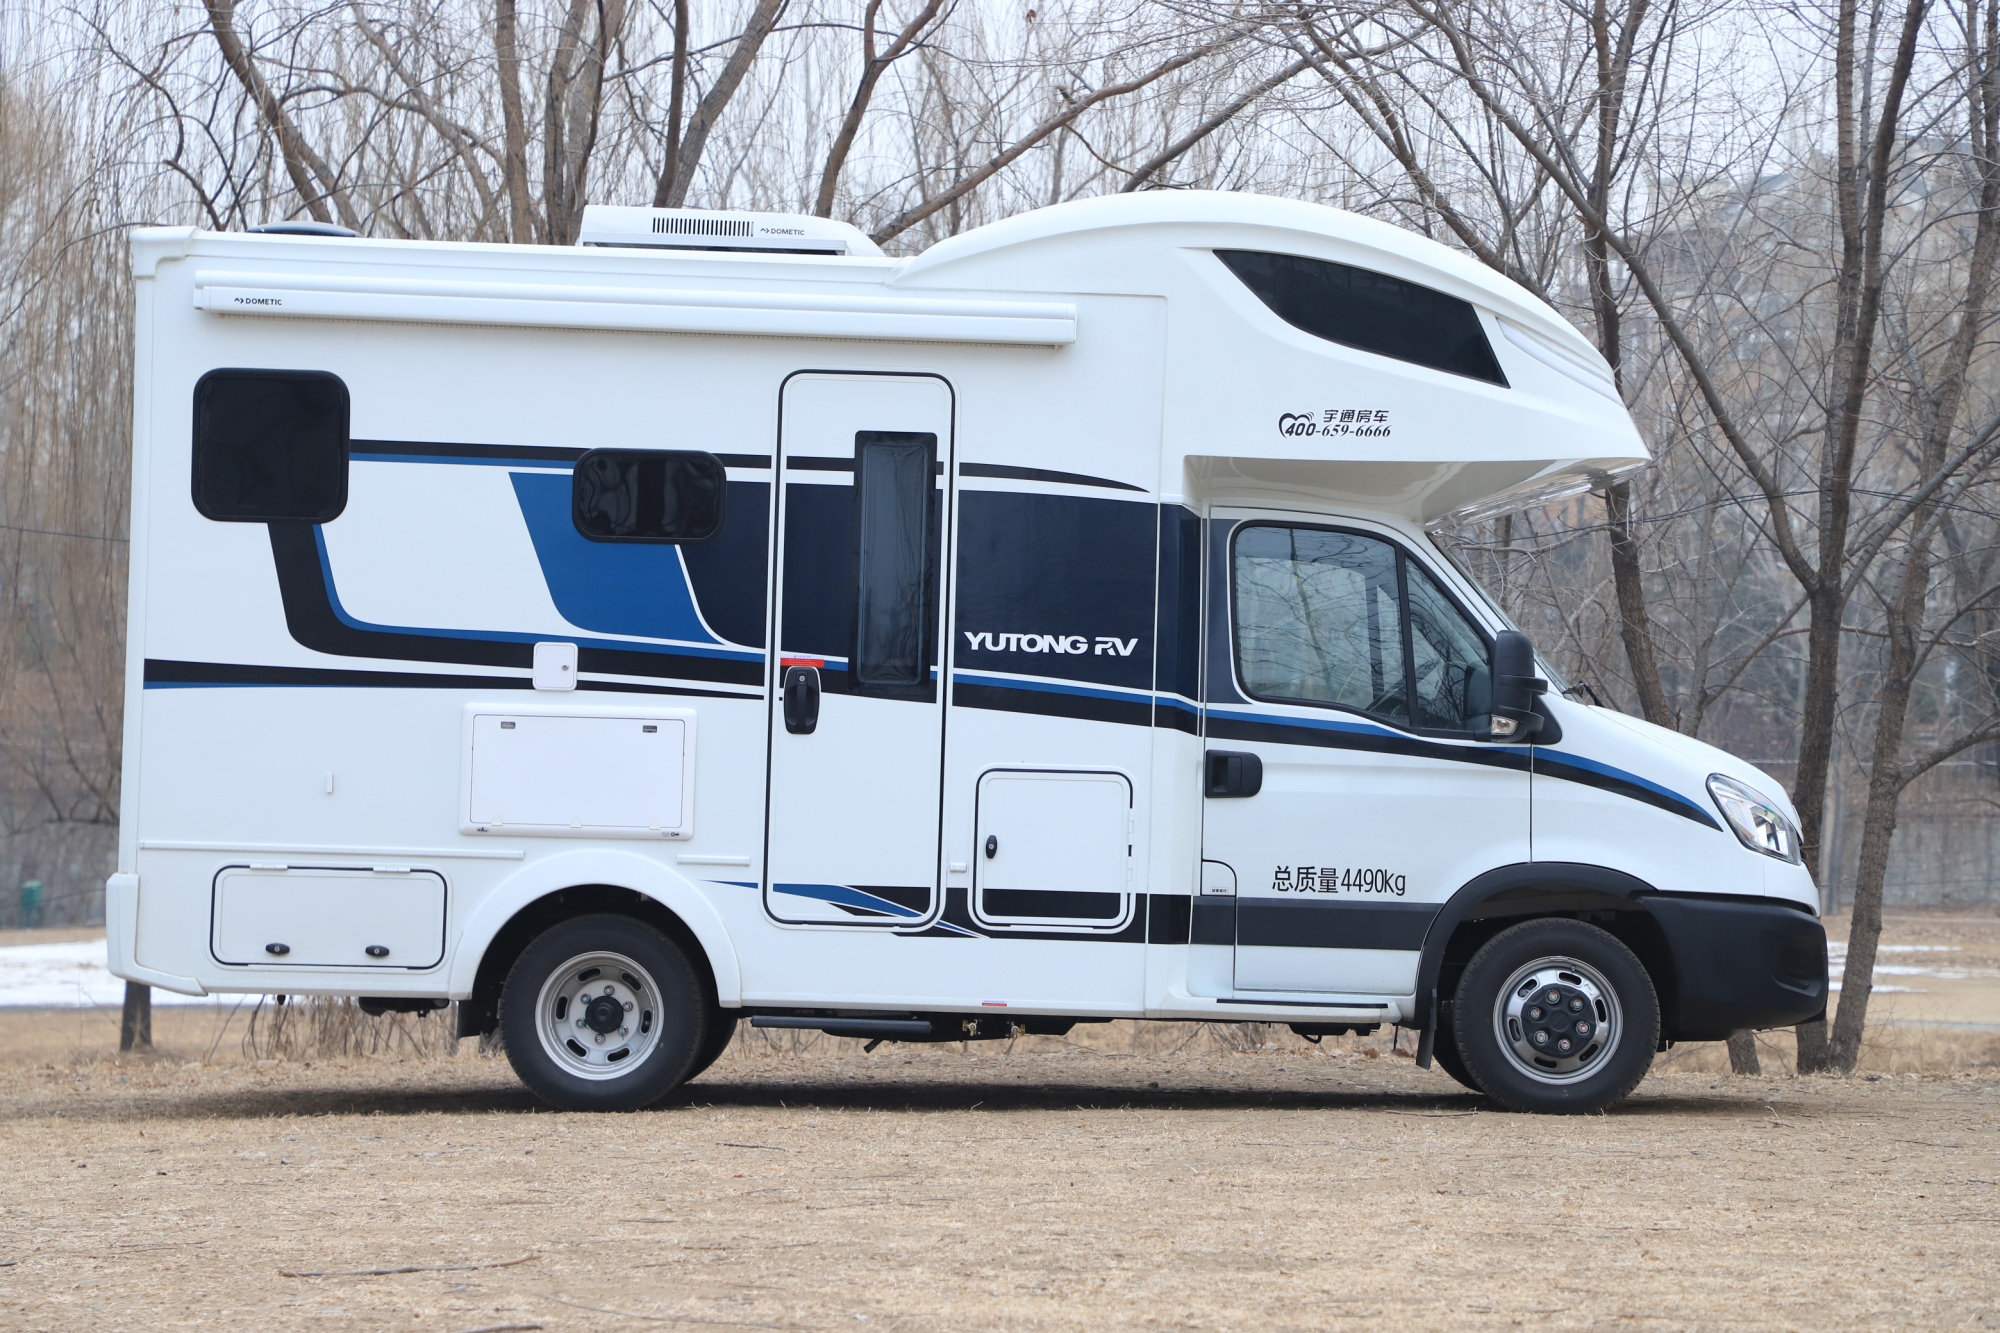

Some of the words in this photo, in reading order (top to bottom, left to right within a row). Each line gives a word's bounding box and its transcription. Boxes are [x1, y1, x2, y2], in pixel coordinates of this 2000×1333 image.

[770, 228, 805, 236] DOMETIC
[245, 297, 282, 306] DOMETIC
[1323, 409, 1389, 423] 宇通房车
[1285, 422, 1393, 438] 400-659-6666
[963, 631, 1088, 655] YUTONG
[1094, 636, 1138, 657] RV
